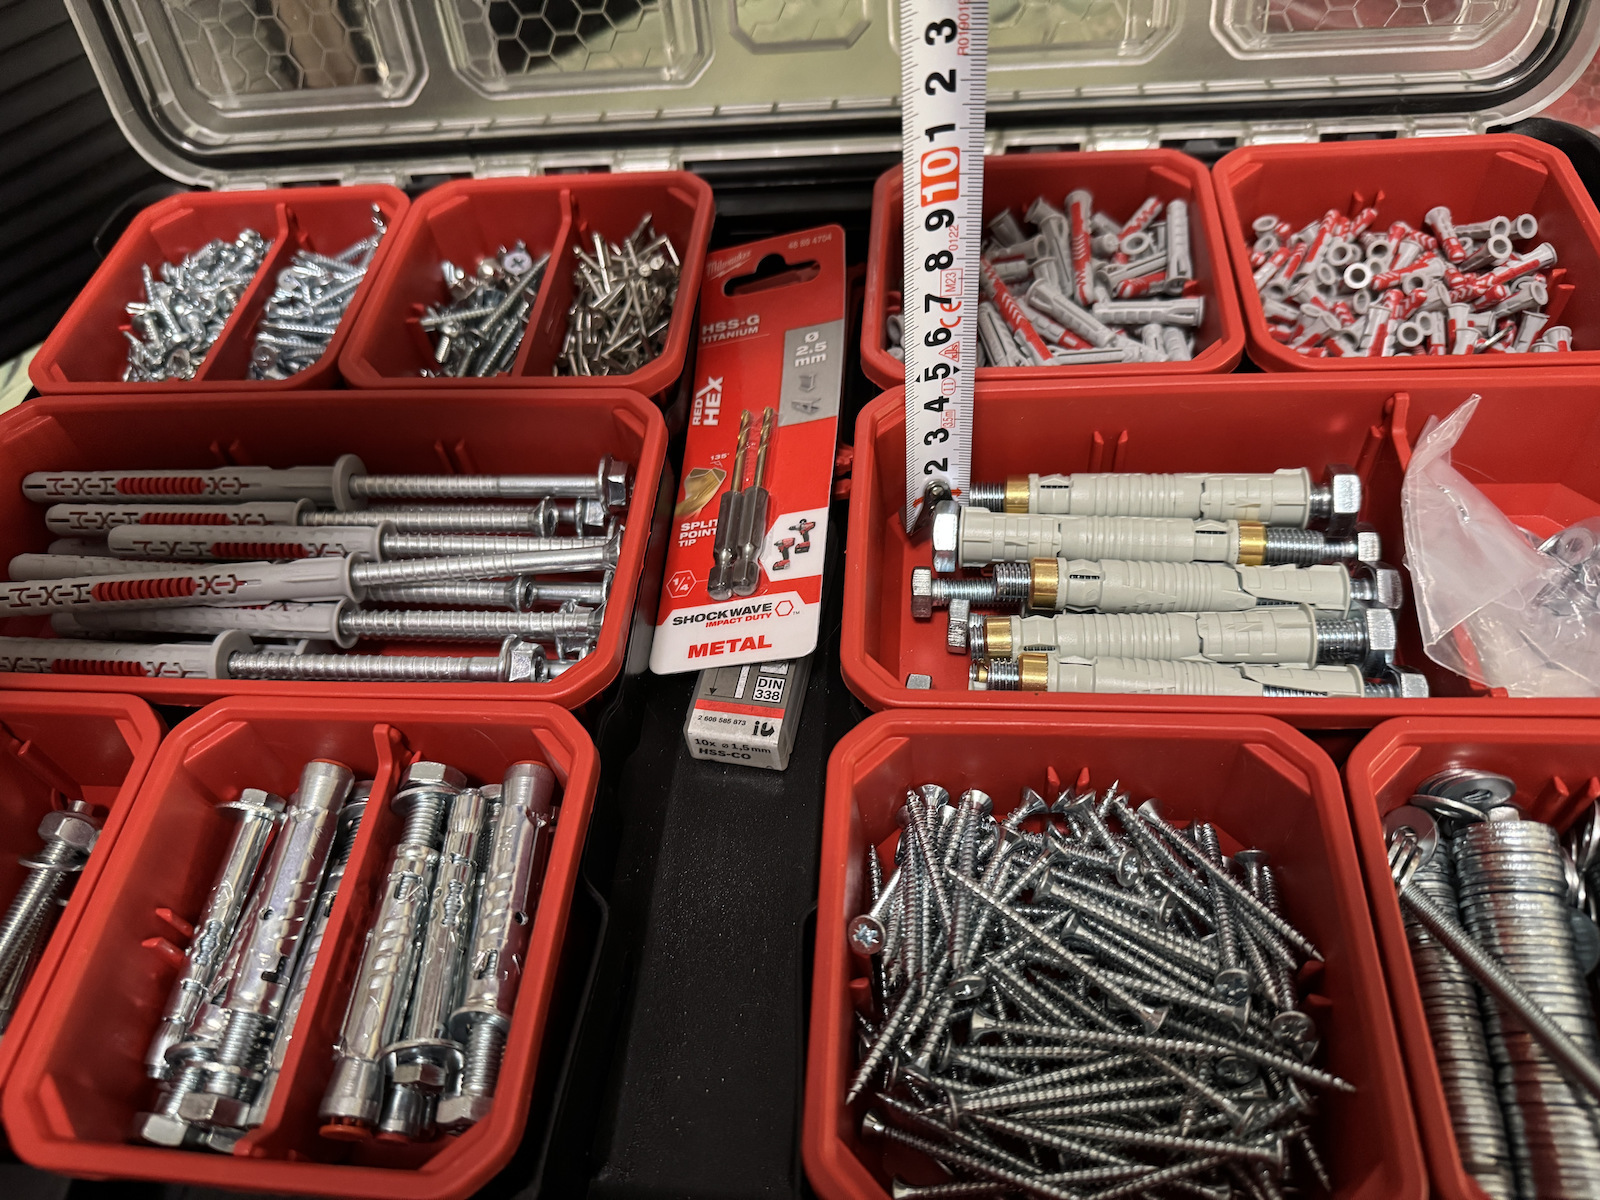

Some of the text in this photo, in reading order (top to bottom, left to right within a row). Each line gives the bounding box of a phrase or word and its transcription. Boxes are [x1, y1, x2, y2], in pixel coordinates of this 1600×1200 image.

[925, 18, 958, 45] 3
[925, 69, 956, 96] 2
[925, 123, 956, 143] 1
[922, 150, 959, 202] 10
[925, 208, 955, 232] 9
[812, 232, 832, 244] 4704
[948, 224, 959, 251] 0122
[924, 250, 953, 272] 8
[945, 272, 957, 293] M23
[924, 293, 952, 314] 7
[702, 314, 760, 334] HSS-G
[701, 327, 758, 344] TITANIUM
[924, 327, 951, 347] 6
[795, 341, 827, 356] 2.5
[795, 353, 826, 367] mm
[924, 363, 951, 382] 5
[702, 376, 724, 426] HEX
[923, 396, 950, 413] 4
[692, 399, 704, 426] RED
[923, 427, 949, 446] 3
[923, 457, 948, 475] 2
[679, 528, 717, 540] POINT
[681, 519, 719, 531] SPLIT
[678, 538, 697, 548] TIP
[672, 602, 773, 626] SHOCKWAVE
[705, 611, 773, 628] IMPACT DUTY
[687, 635, 773, 659] METAL
[757, 678, 783, 690] DIN
[754, 689, 780, 701] 338
[694, 738, 716, 747] 10x
[698, 747, 752, 760] HSS-CO
